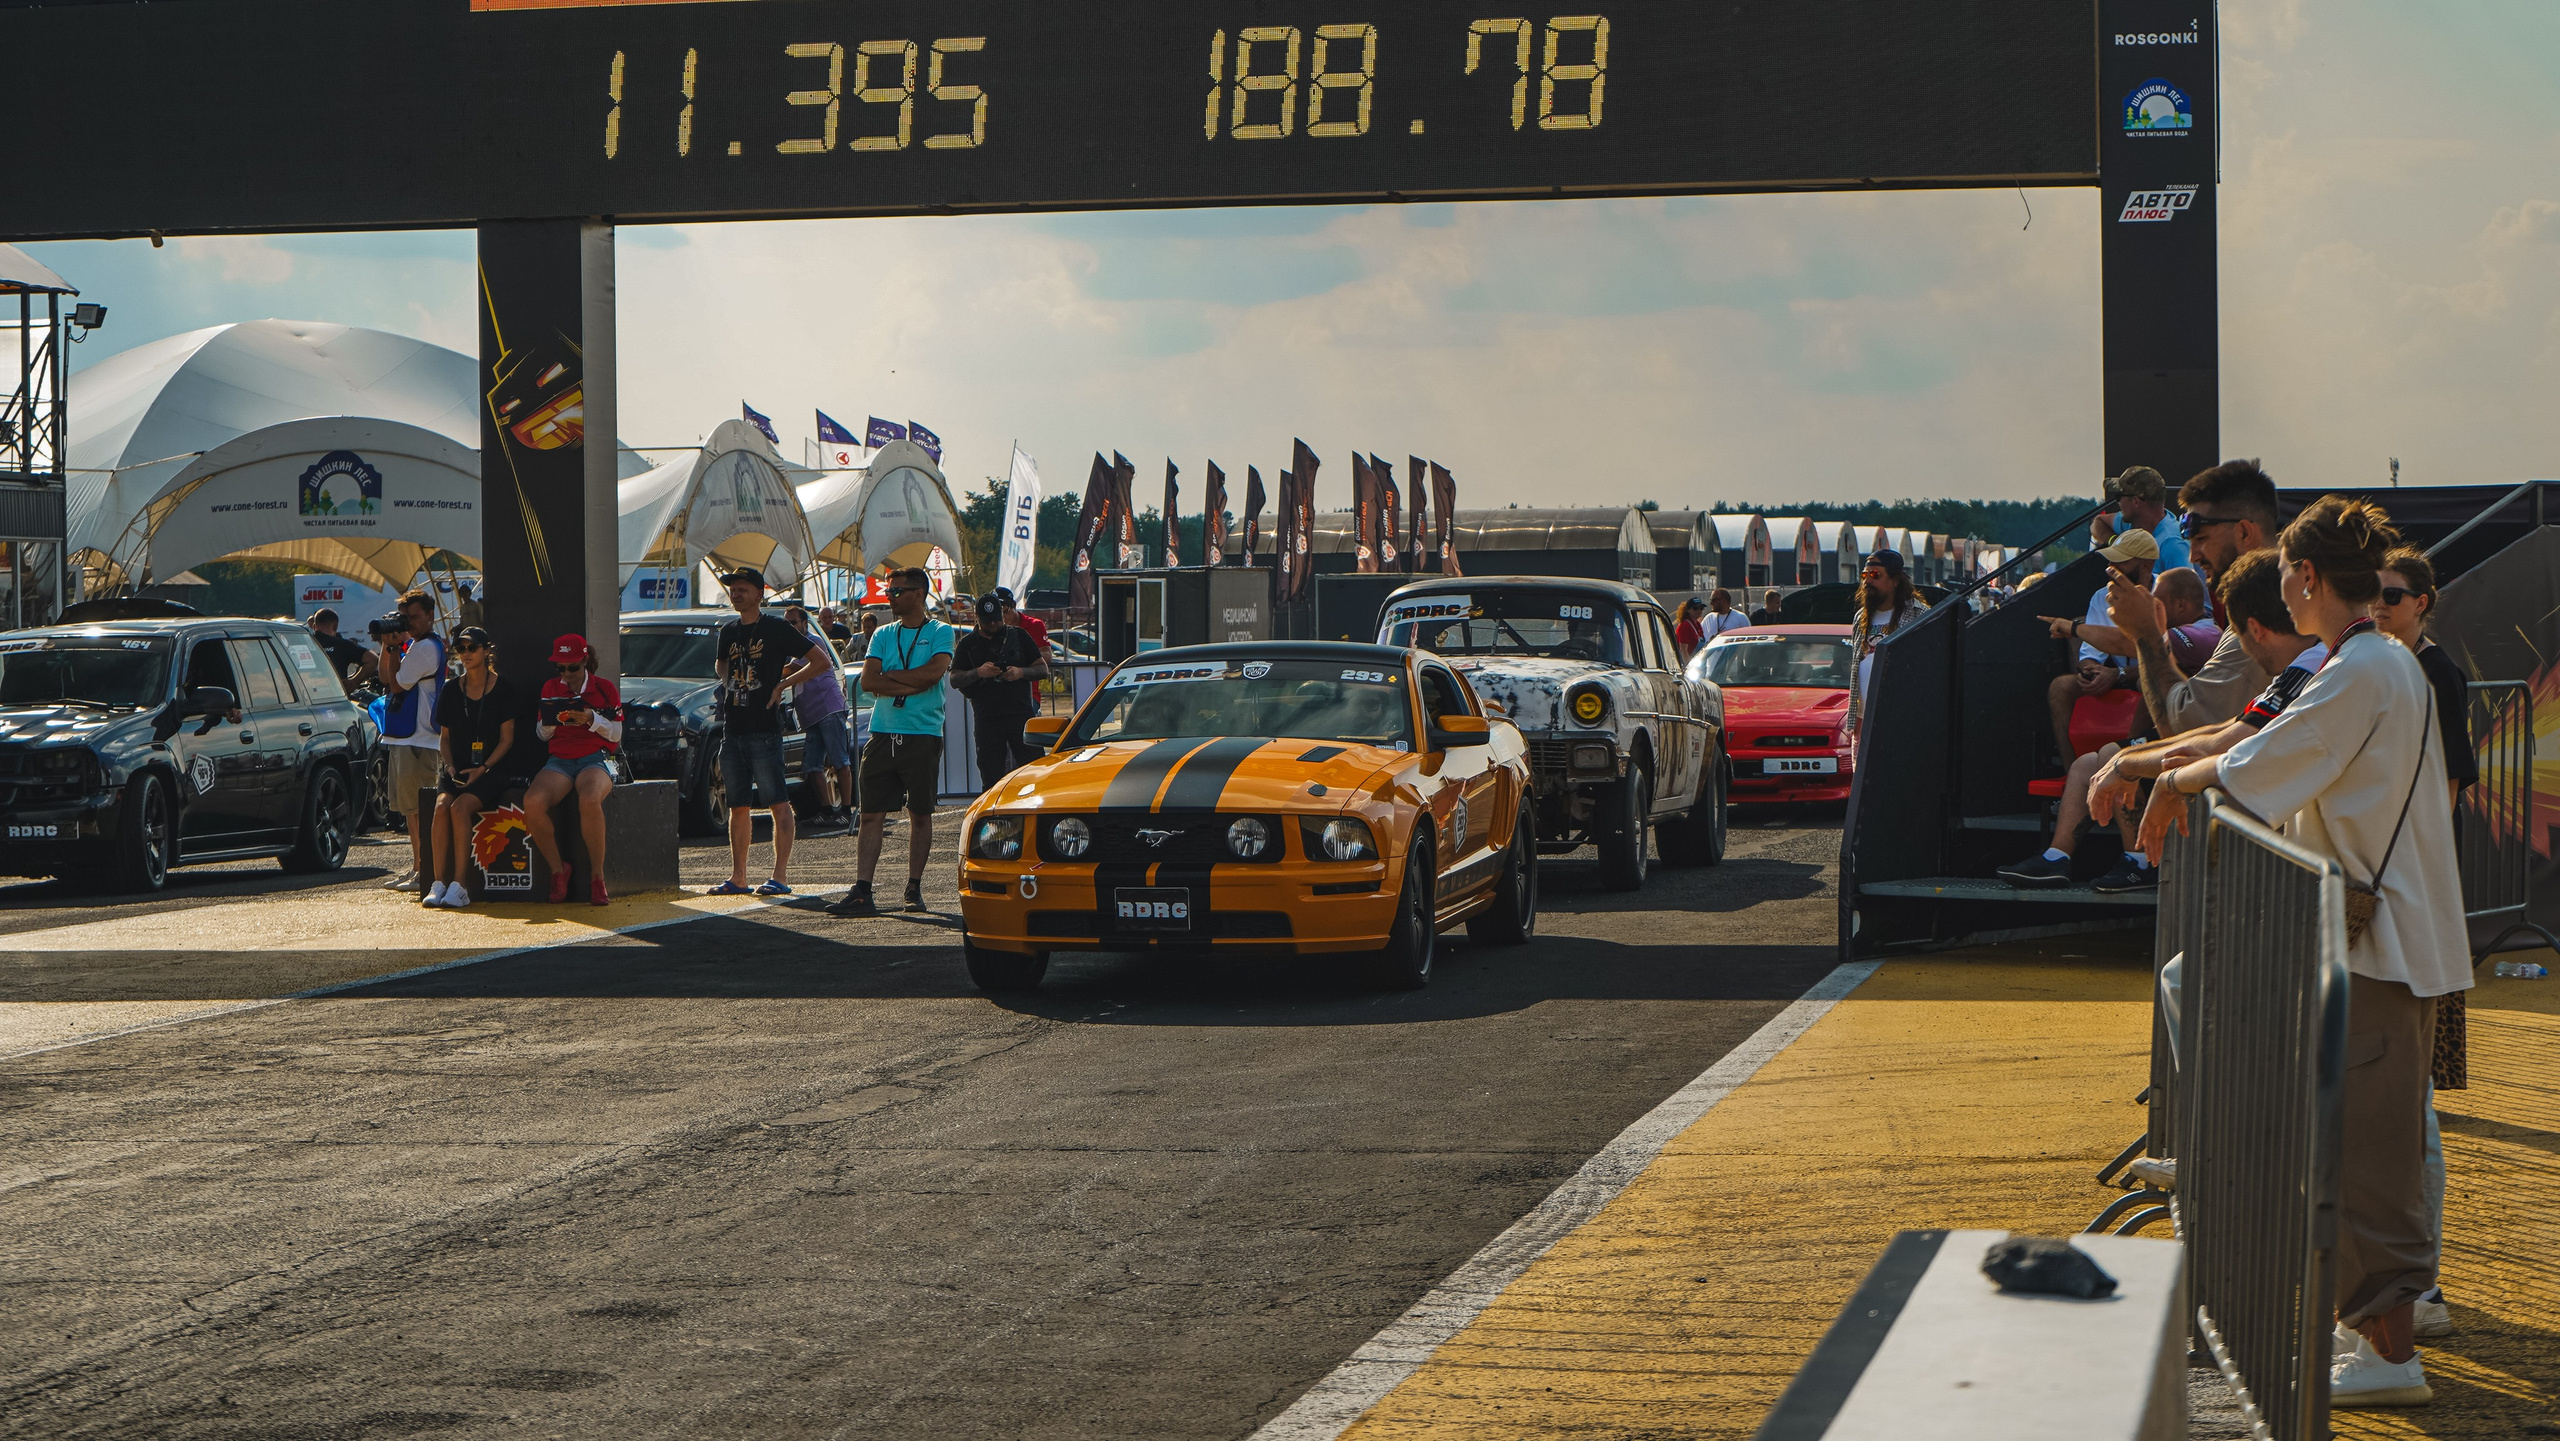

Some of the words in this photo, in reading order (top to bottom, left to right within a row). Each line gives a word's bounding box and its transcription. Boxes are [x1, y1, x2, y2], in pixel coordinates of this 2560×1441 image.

[2115, 32, 2198, 45] ROSGONKI
[605, 37, 987, 159] 11.395
[1204, 15, 1609, 140] 188.78
[2131, 85, 2167, 107] ШИШКИН
[2168, 89, 2184, 106] ЛЕС
[2128, 192, 2191, 208] АВТО
[2123, 209, 2169, 220] ПЛЮС
[308, 460, 353, 488] ШИШКИН
[354, 464, 372, 487] ЛЕС
[211, 500, 288, 513] www.cone-forest.ru
[393, 499, 472, 510] www.cone-forest.ru
[1014, 495, 1032, 540] ВТБ
[1223, 603, 1257, 625] МЕДИЦИНСКИЙ
[1402, 604, 1461, 619] RDRC
[1559, 605, 1593, 619] 808
[684, 627, 710, 635] 130
[121, 640, 151, 649] 464
[1134, 668, 1213, 682] RDRC
[1340, 669, 1384, 682] 293
[1780, 761, 1821, 770] RDRC
[9, 825, 58, 837] RDRC
[487, 875, 531, 887] RDRC
[1117, 902, 1188, 918] RDRC
